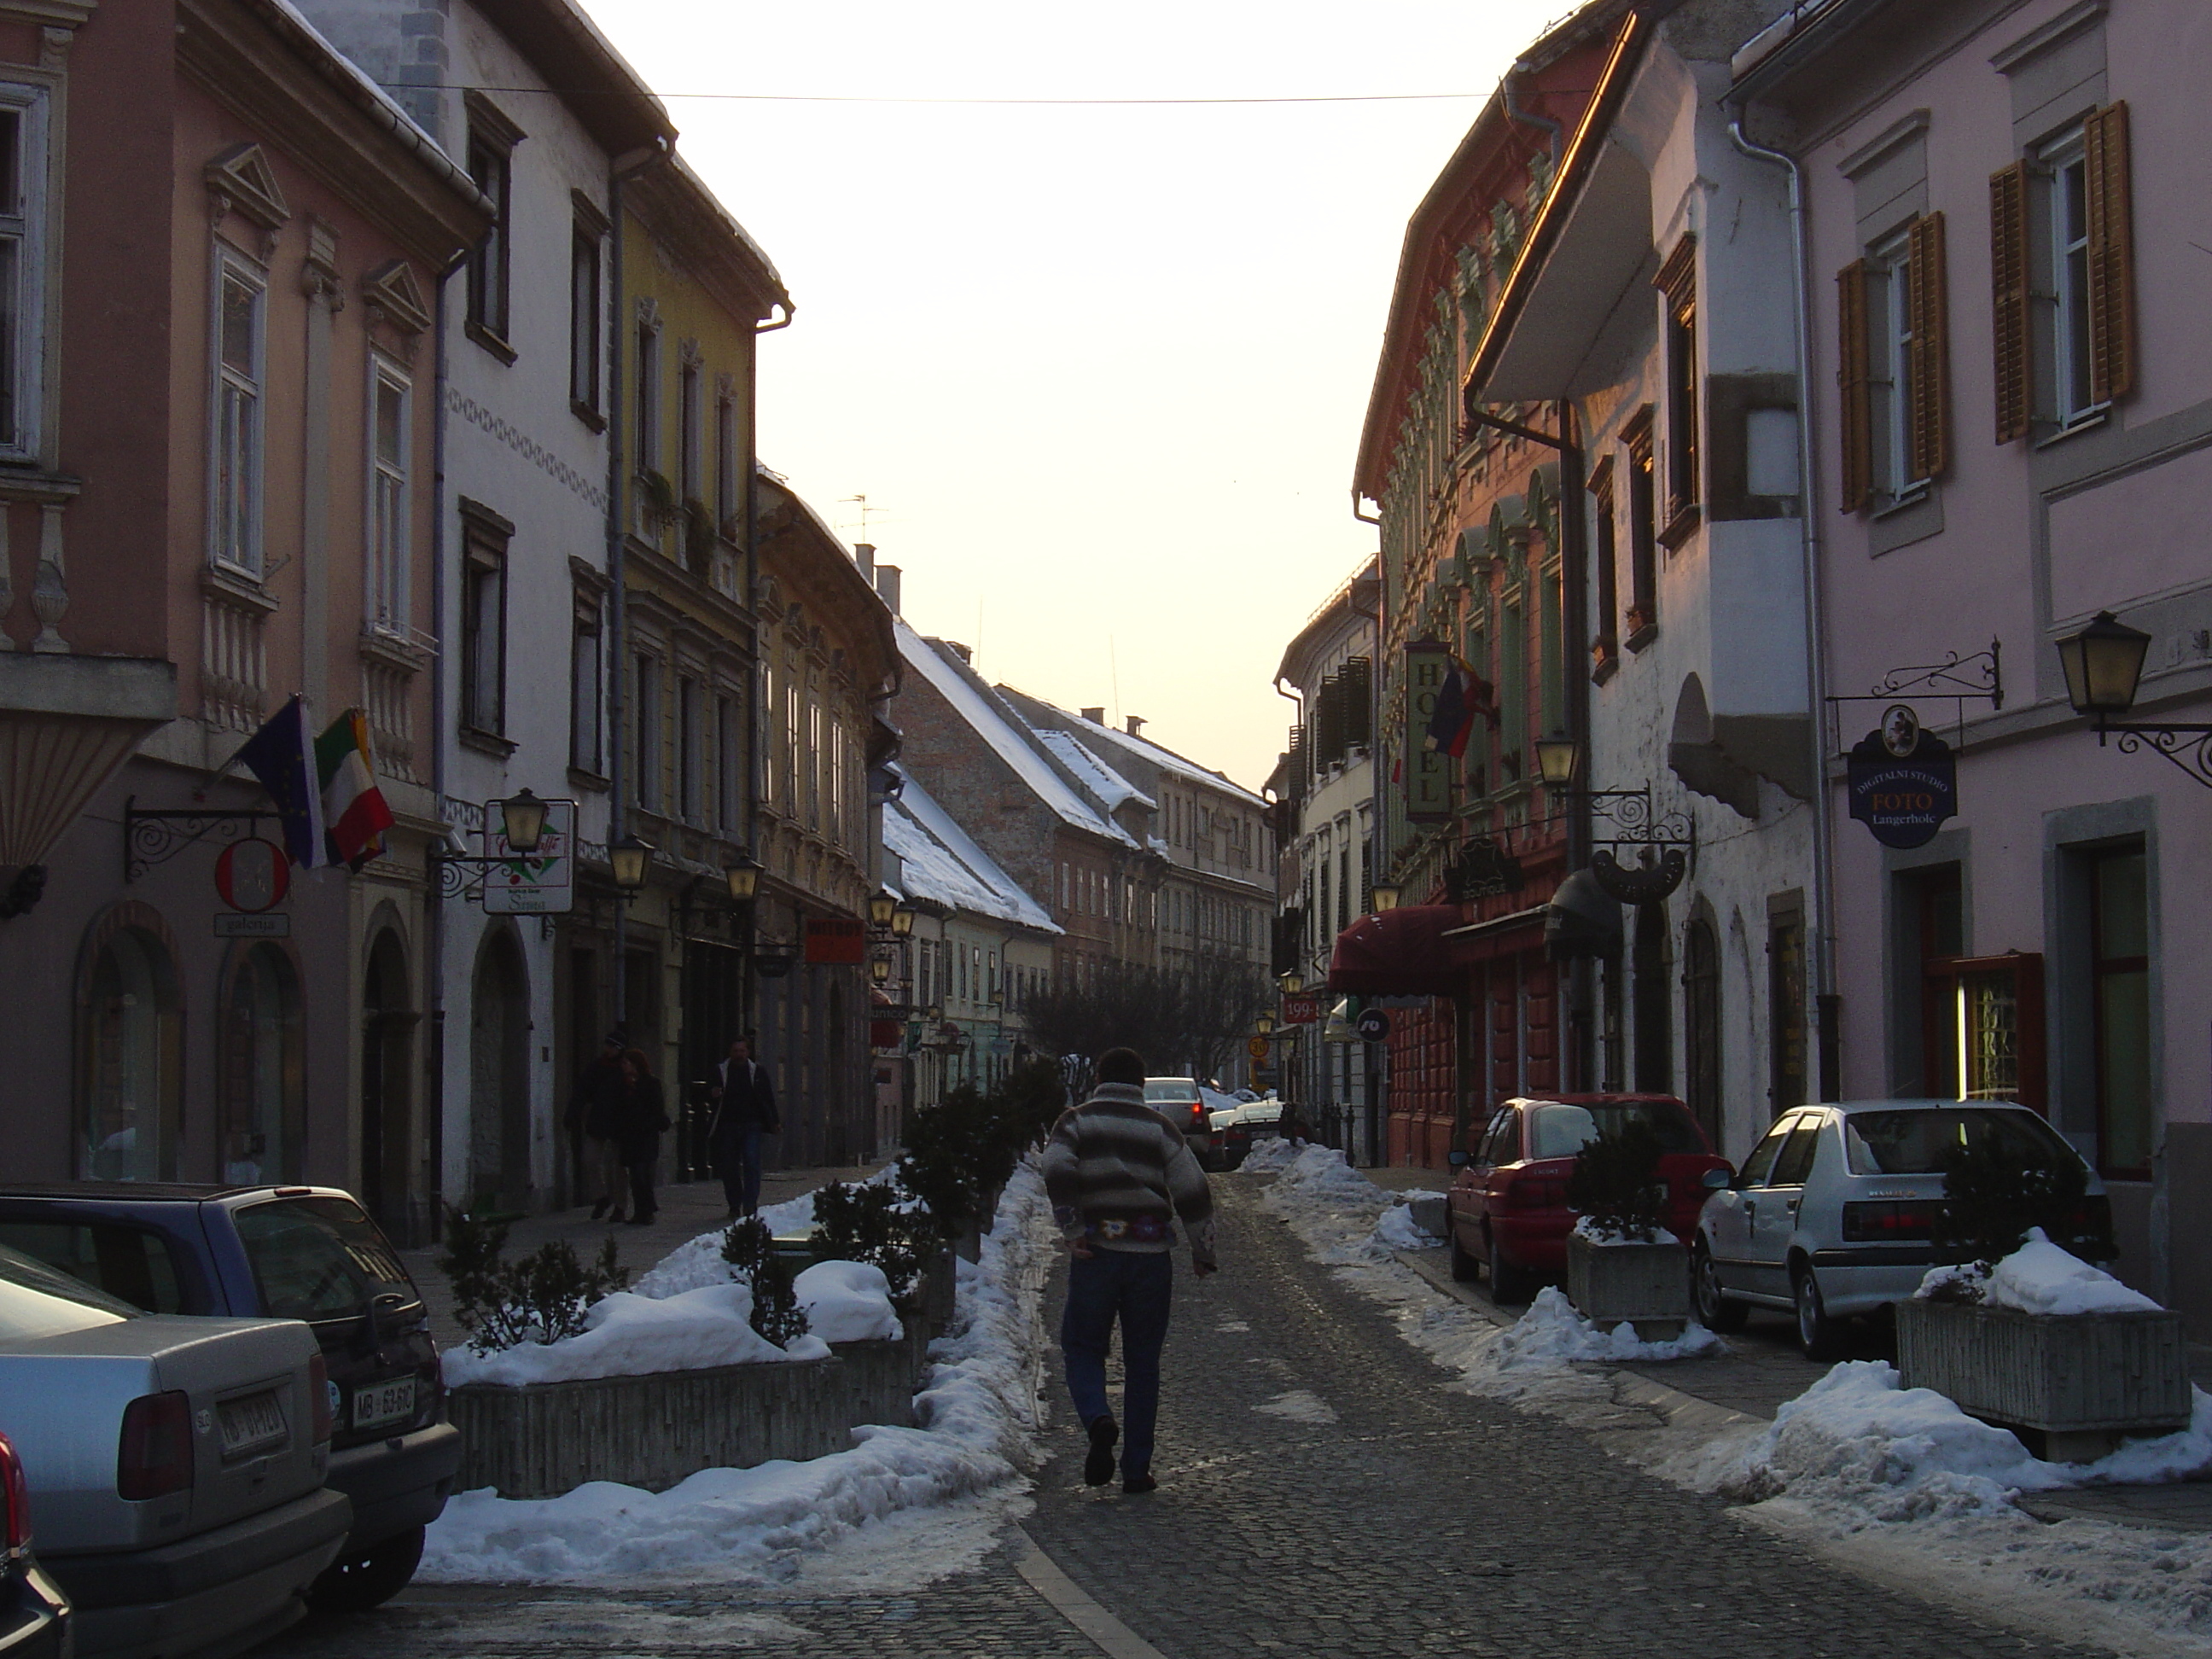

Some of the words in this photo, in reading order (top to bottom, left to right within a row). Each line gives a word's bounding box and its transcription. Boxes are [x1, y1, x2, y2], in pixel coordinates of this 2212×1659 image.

[1857, 770, 1908, 795] DIGITALNI
[1911, 771, 1948, 793] STUDIO
[1871, 793, 1933, 811] FOTO
[1872, 813, 1936, 826] Langerholc
[1462, 882, 1506, 900] BOUTIQUE
[227, 917, 275, 933] galerija
[358, 1394, 373, 1419] MB
[196, 1413, 211, 1429] SLO
